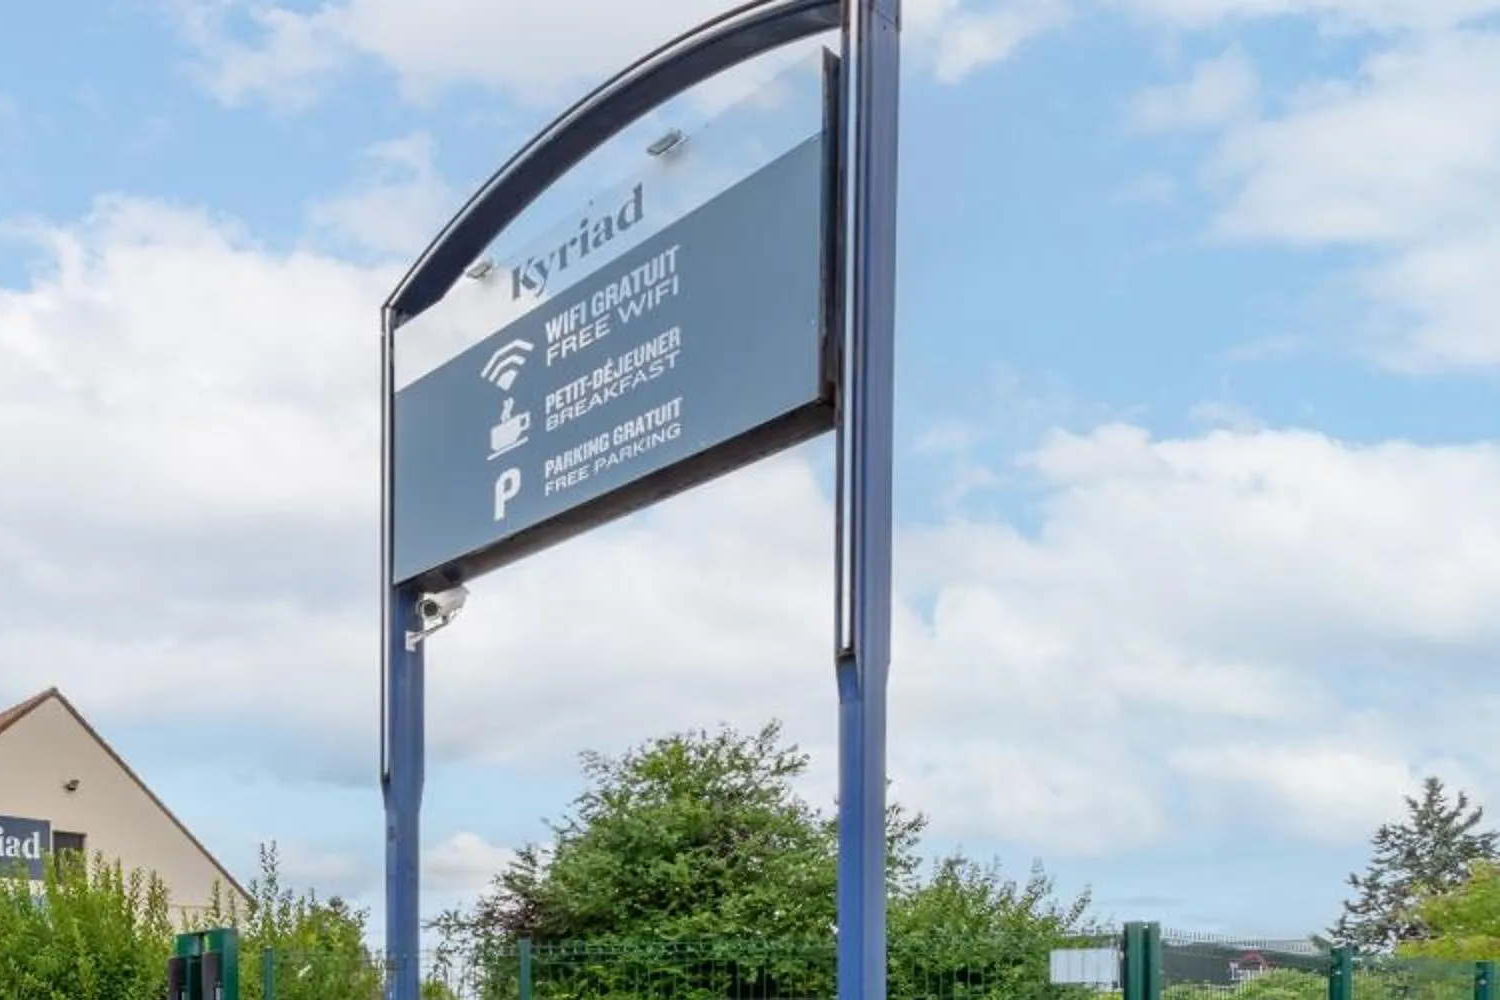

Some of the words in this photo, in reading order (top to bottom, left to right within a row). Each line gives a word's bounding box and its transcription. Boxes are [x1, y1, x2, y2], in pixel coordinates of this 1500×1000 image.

[512, 182, 644, 301] Kyriad
[545, 301, 587, 343] WIFI
[591, 245, 680, 317] GRATUIT
[546, 313, 611, 366] FREE
[617, 274, 679, 323] WIFI
[545, 326, 681, 414] PETIT-DÉJEUNER
[545, 349, 681, 432] BREAKFAST
[544, 432, 609, 478] PARKING
[613, 396, 683, 446] GRATUIT
[545, 464, 589, 497] FREE
[594, 423, 682, 474] PARKING
